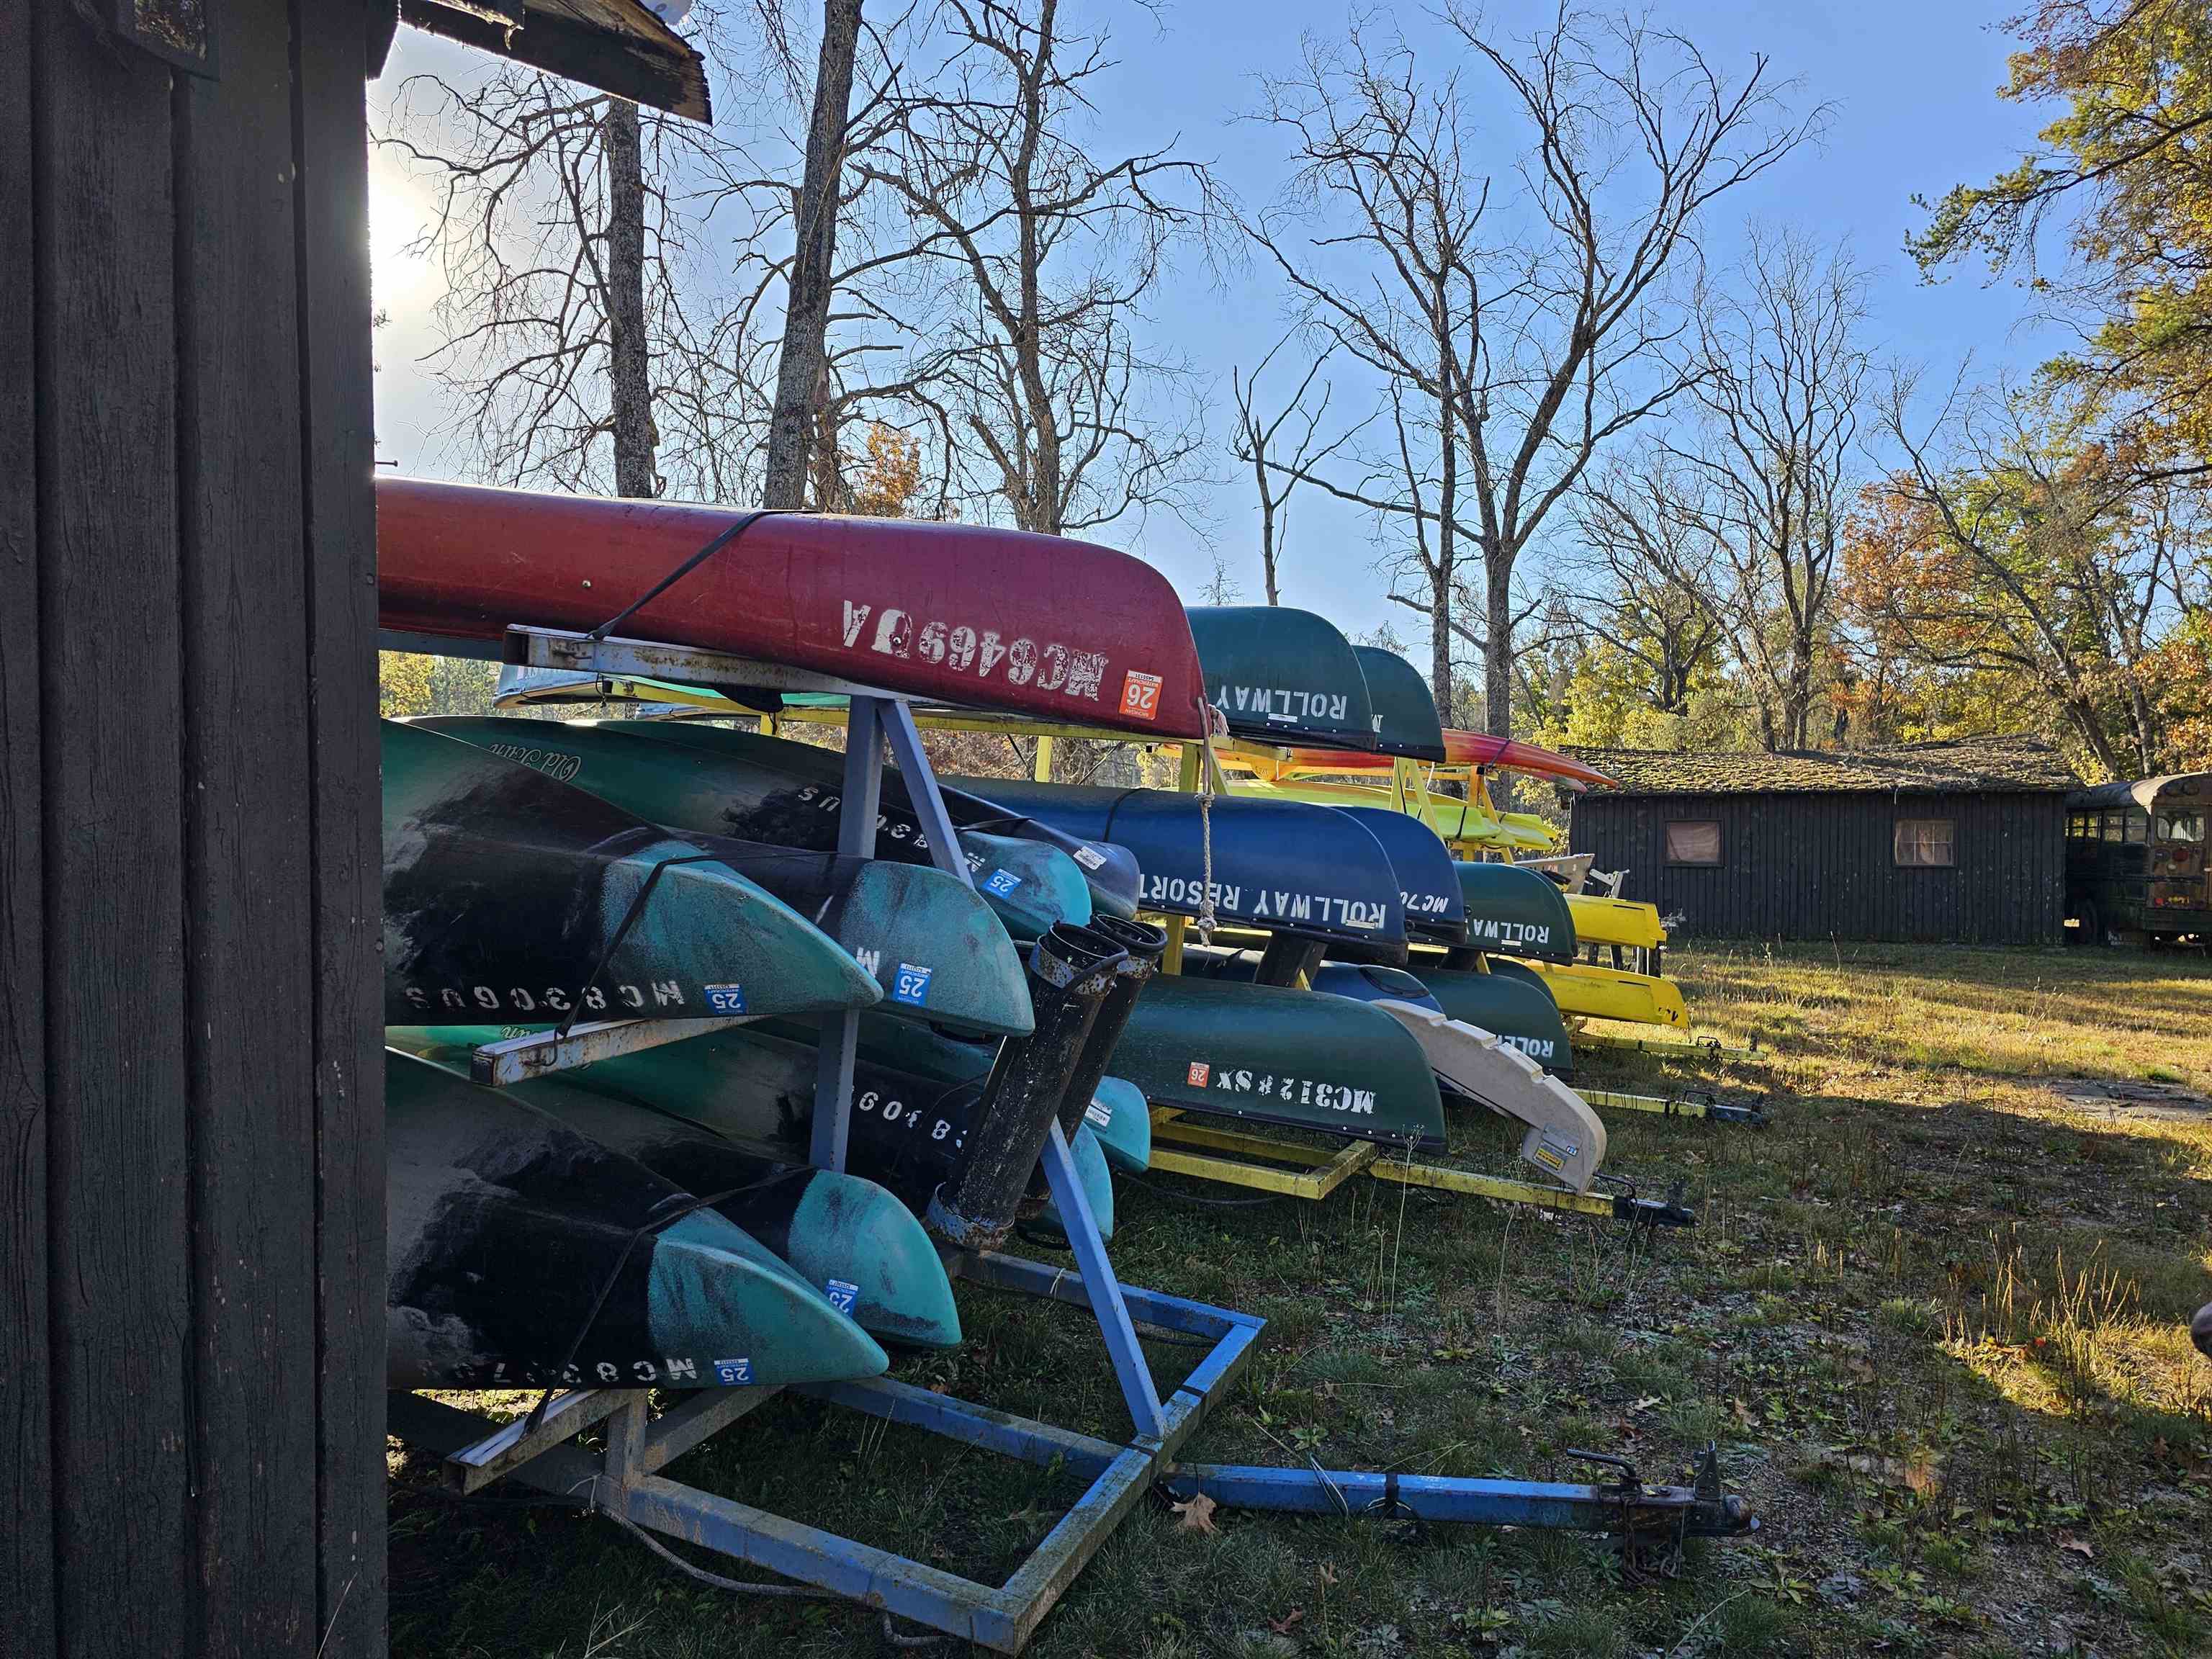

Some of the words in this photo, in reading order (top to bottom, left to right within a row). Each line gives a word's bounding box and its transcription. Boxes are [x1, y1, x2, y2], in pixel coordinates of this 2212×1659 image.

[1127, 684, 1155, 709] 26
[1215, 685, 1348, 721] ROLLWAY
[541, 752, 582, 783] Old
[991, 876, 1015, 893] 25
[1138, 873, 1241, 911] RESORT
[1253, 889, 1386, 929] ROLLWAY
[899, 976, 926, 997] 25
[711, 994, 742, 1009] 25
[1498, 1035, 1555, 1059] ROLL
[1191, 1069, 1206, 1082] 26
[721, 1367, 749, 1382] 25
